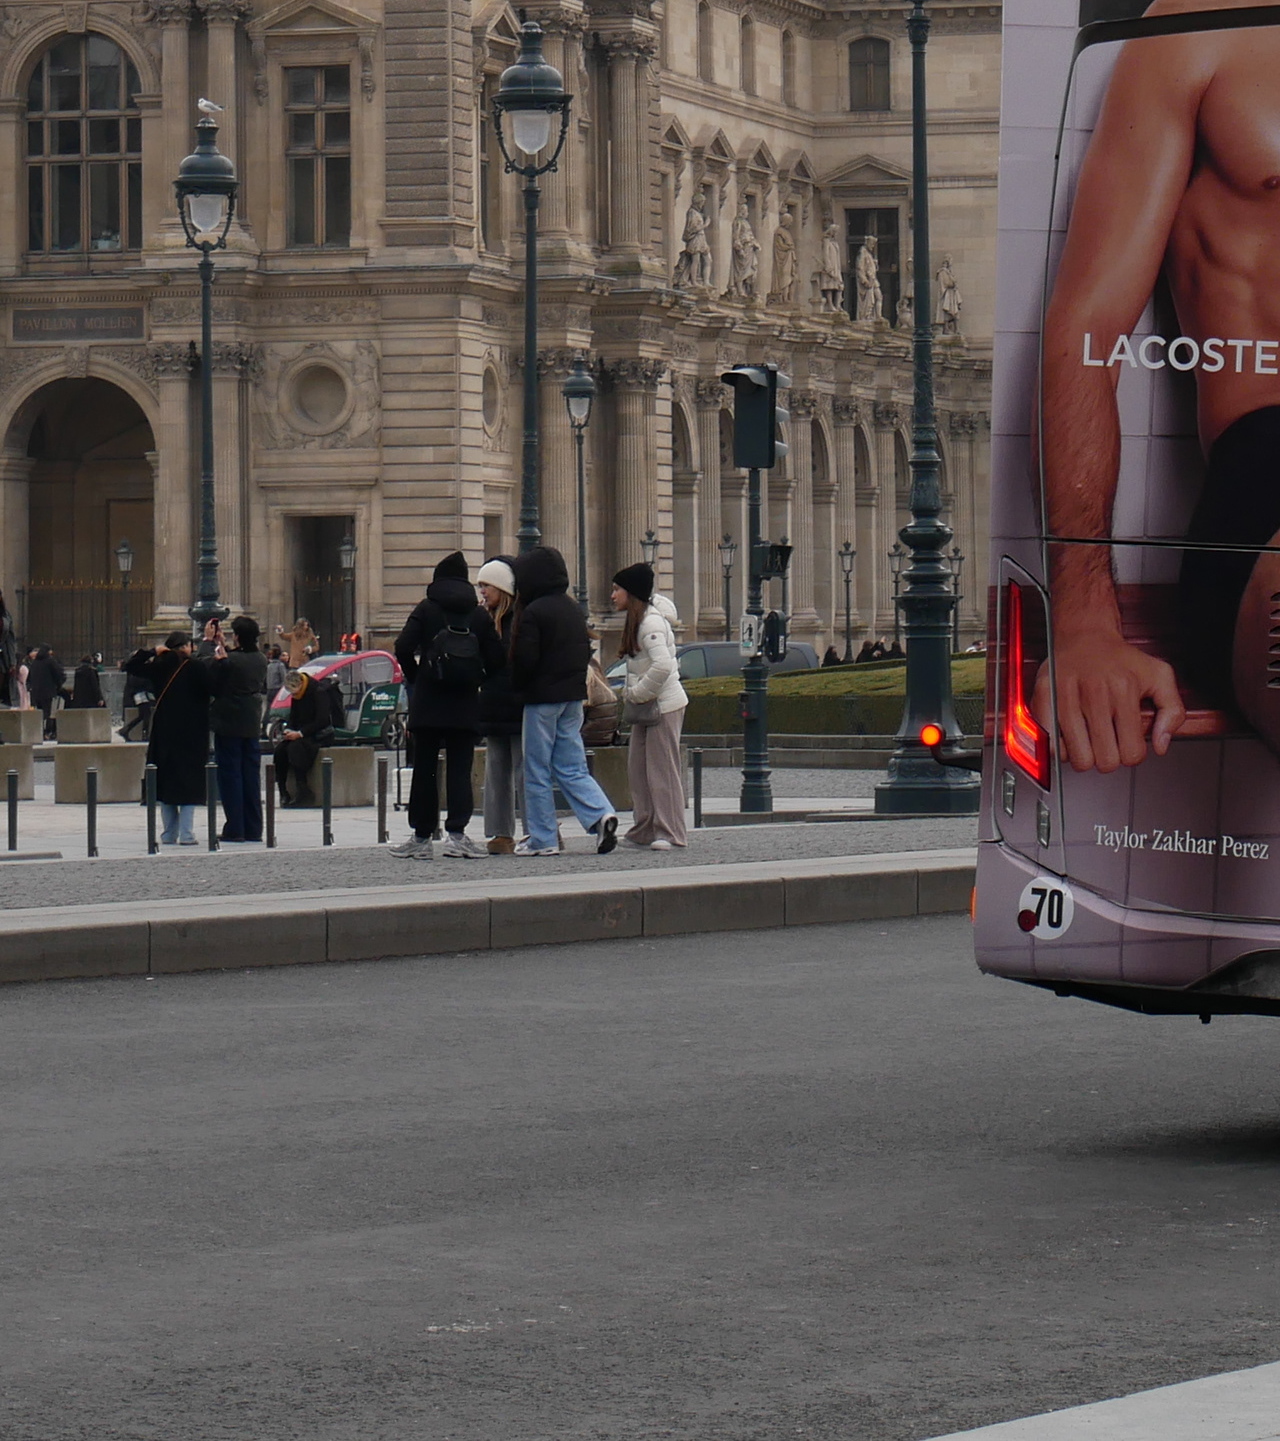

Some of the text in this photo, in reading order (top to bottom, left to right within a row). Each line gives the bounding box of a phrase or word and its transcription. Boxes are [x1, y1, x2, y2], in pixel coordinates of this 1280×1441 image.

[1082, 333, 1279, 374] LACOSTE
[1093, 824, 1270, 860] Taylor Zakhar Perez
[1031, 887, 1064, 929] 70
